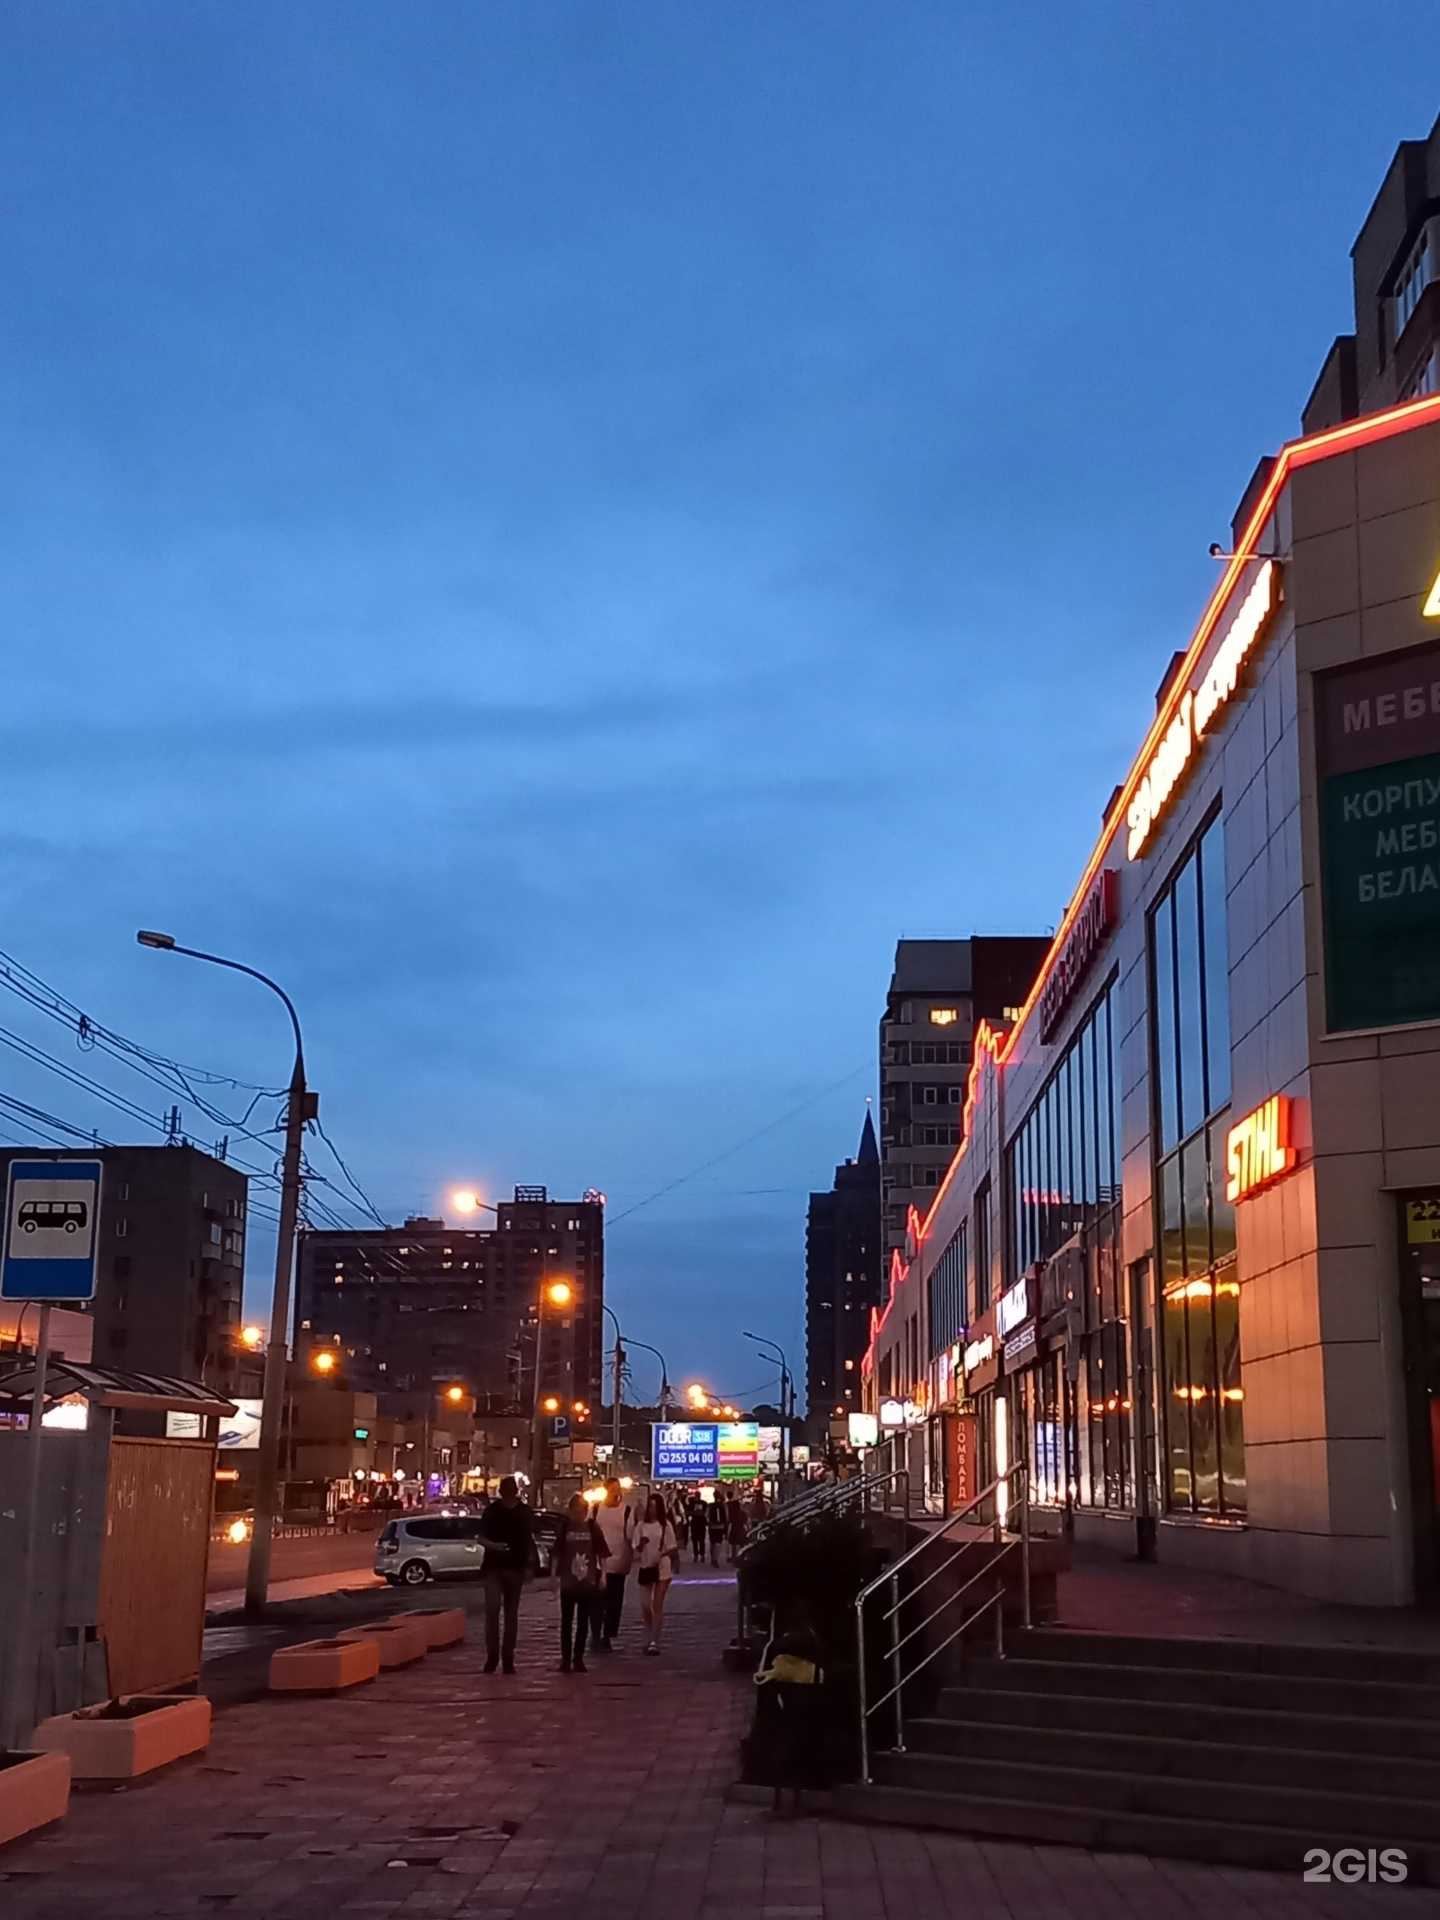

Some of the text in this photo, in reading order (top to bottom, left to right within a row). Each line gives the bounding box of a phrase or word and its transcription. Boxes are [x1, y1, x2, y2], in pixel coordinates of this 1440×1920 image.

[1375, 818, 1440, 858] МЕБ
[1358, 862, 1440, 903] БЕЛА
[670, 1452, 687, 1464] 255
[688, 1452, 700, 1464] 04
[701, 1452, 714, 1464] 00
